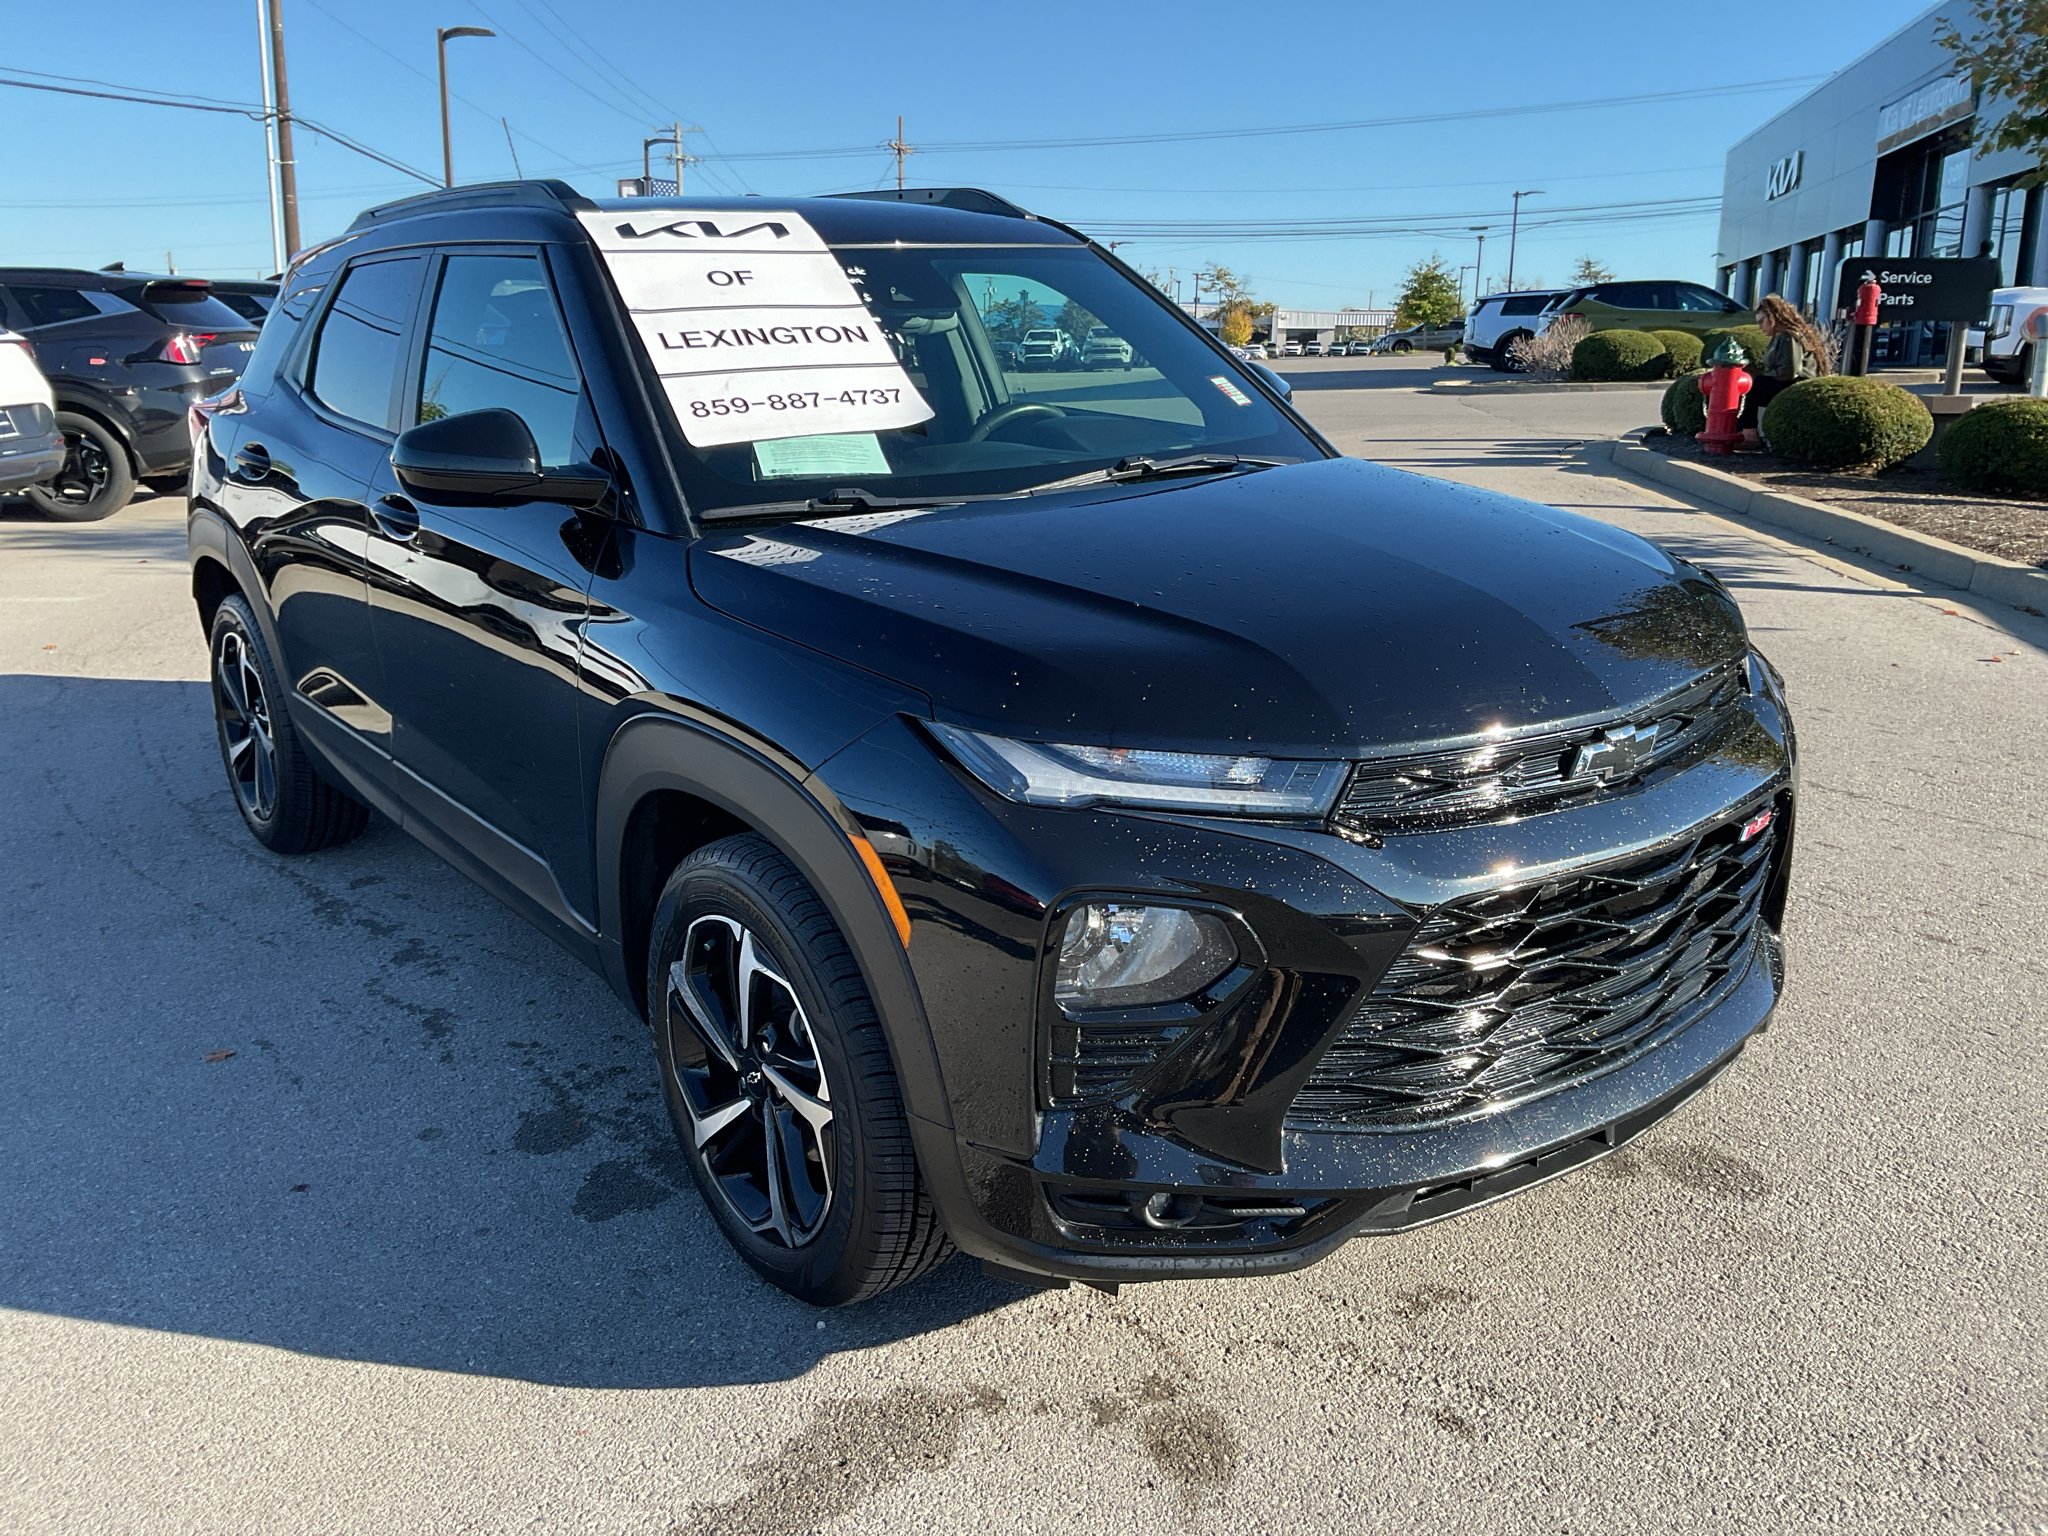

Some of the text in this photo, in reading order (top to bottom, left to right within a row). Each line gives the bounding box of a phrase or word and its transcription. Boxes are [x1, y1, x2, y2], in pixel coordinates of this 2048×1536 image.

[614, 220, 791, 241] KIA
[706, 269, 754, 286] OF
[1880, 270, 1932, 284] Service
[1878, 292, 1914, 306] Parts
[657, 325, 870, 351] LEXINGTON
[689, 387, 901, 419] 859-887-4737
